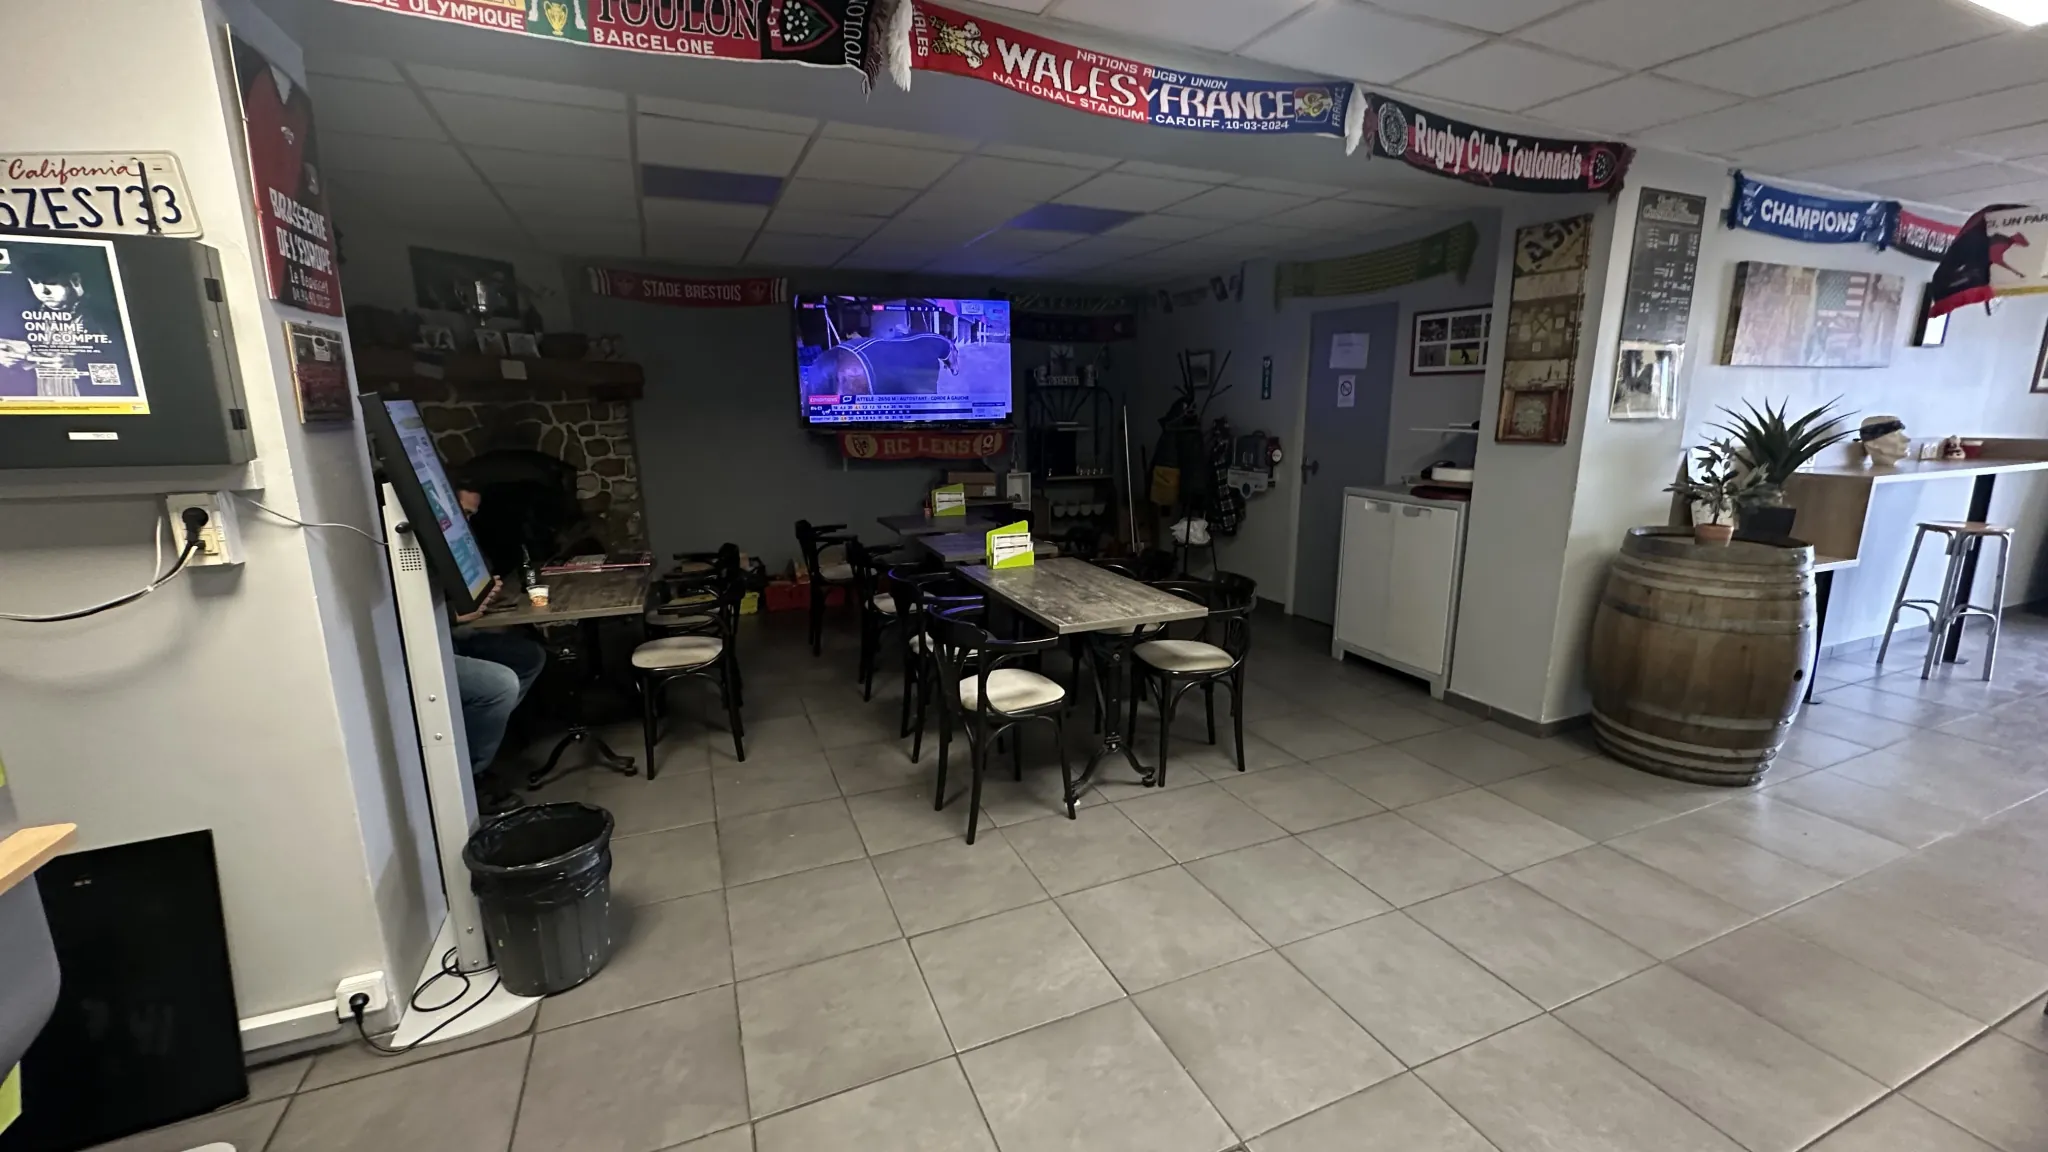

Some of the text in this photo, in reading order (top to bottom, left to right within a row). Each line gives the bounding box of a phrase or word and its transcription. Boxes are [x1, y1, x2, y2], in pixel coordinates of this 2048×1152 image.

[409, 0, 525, 30] OLYMPIQUE
[593, 27, 715, 55] BARCELONE
[995, 36, 1137, 107] WALES
[1159, 83, 1295, 120] FRANCE
[1076, 49, 1228, 90] NATIONS RUGBY UNION
[993, 71, 1076, 105] NATIONAL
[1079, 97, 1145, 121] STADIUM
[1414, 113, 1466, 174] Rugby
[1467, 130, 1502, 175] Club
[1506, 138, 1582, 181] Toulonnais
[8, 156, 141, 185] California
[1760, 198, 1858, 234] CHAMPIONS
[642, 279, 742, 301] STADE BRESTOIS
[21, 310, 73, 321] QUAND
[24, 321, 46, 331] ON
[27, 332, 113, 344] ON COMPTE.
[883, 436, 972, 455] RC LENS
